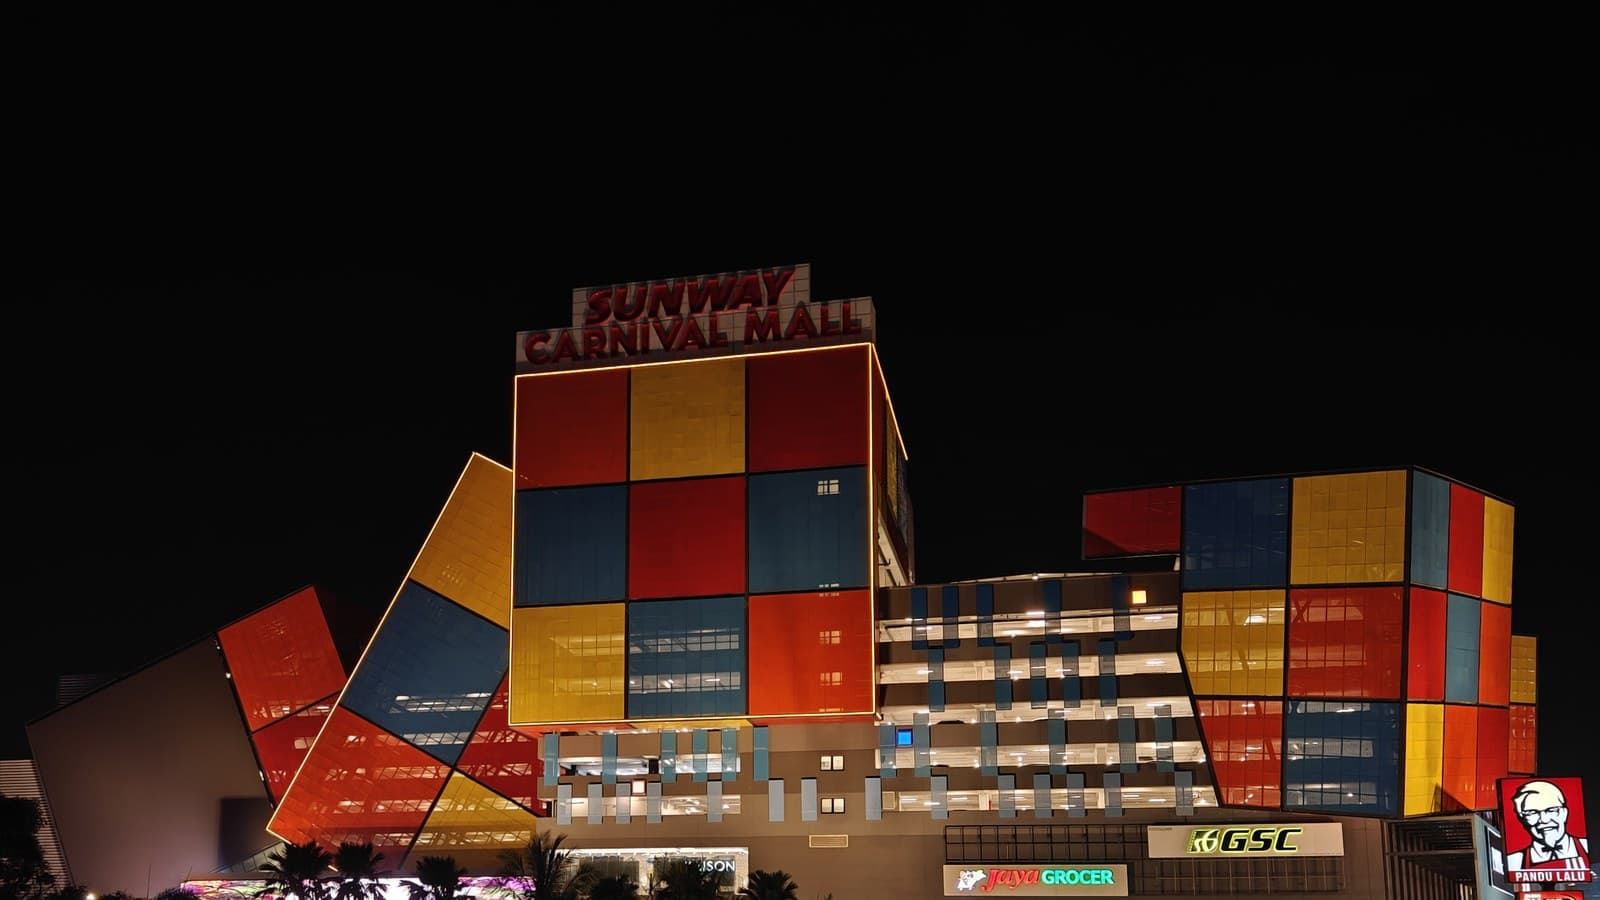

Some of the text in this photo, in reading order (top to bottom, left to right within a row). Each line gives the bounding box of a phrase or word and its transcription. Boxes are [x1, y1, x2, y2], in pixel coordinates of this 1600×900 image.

[584, 270, 795, 325] SUNWAY
[524, 302, 862, 365] CARNIVAL MALL
[1220, 828, 1303, 852] GSC
[1041, 869, 1114, 885] GROCER
[1515, 871, 1585, 882] PANDU LALU
